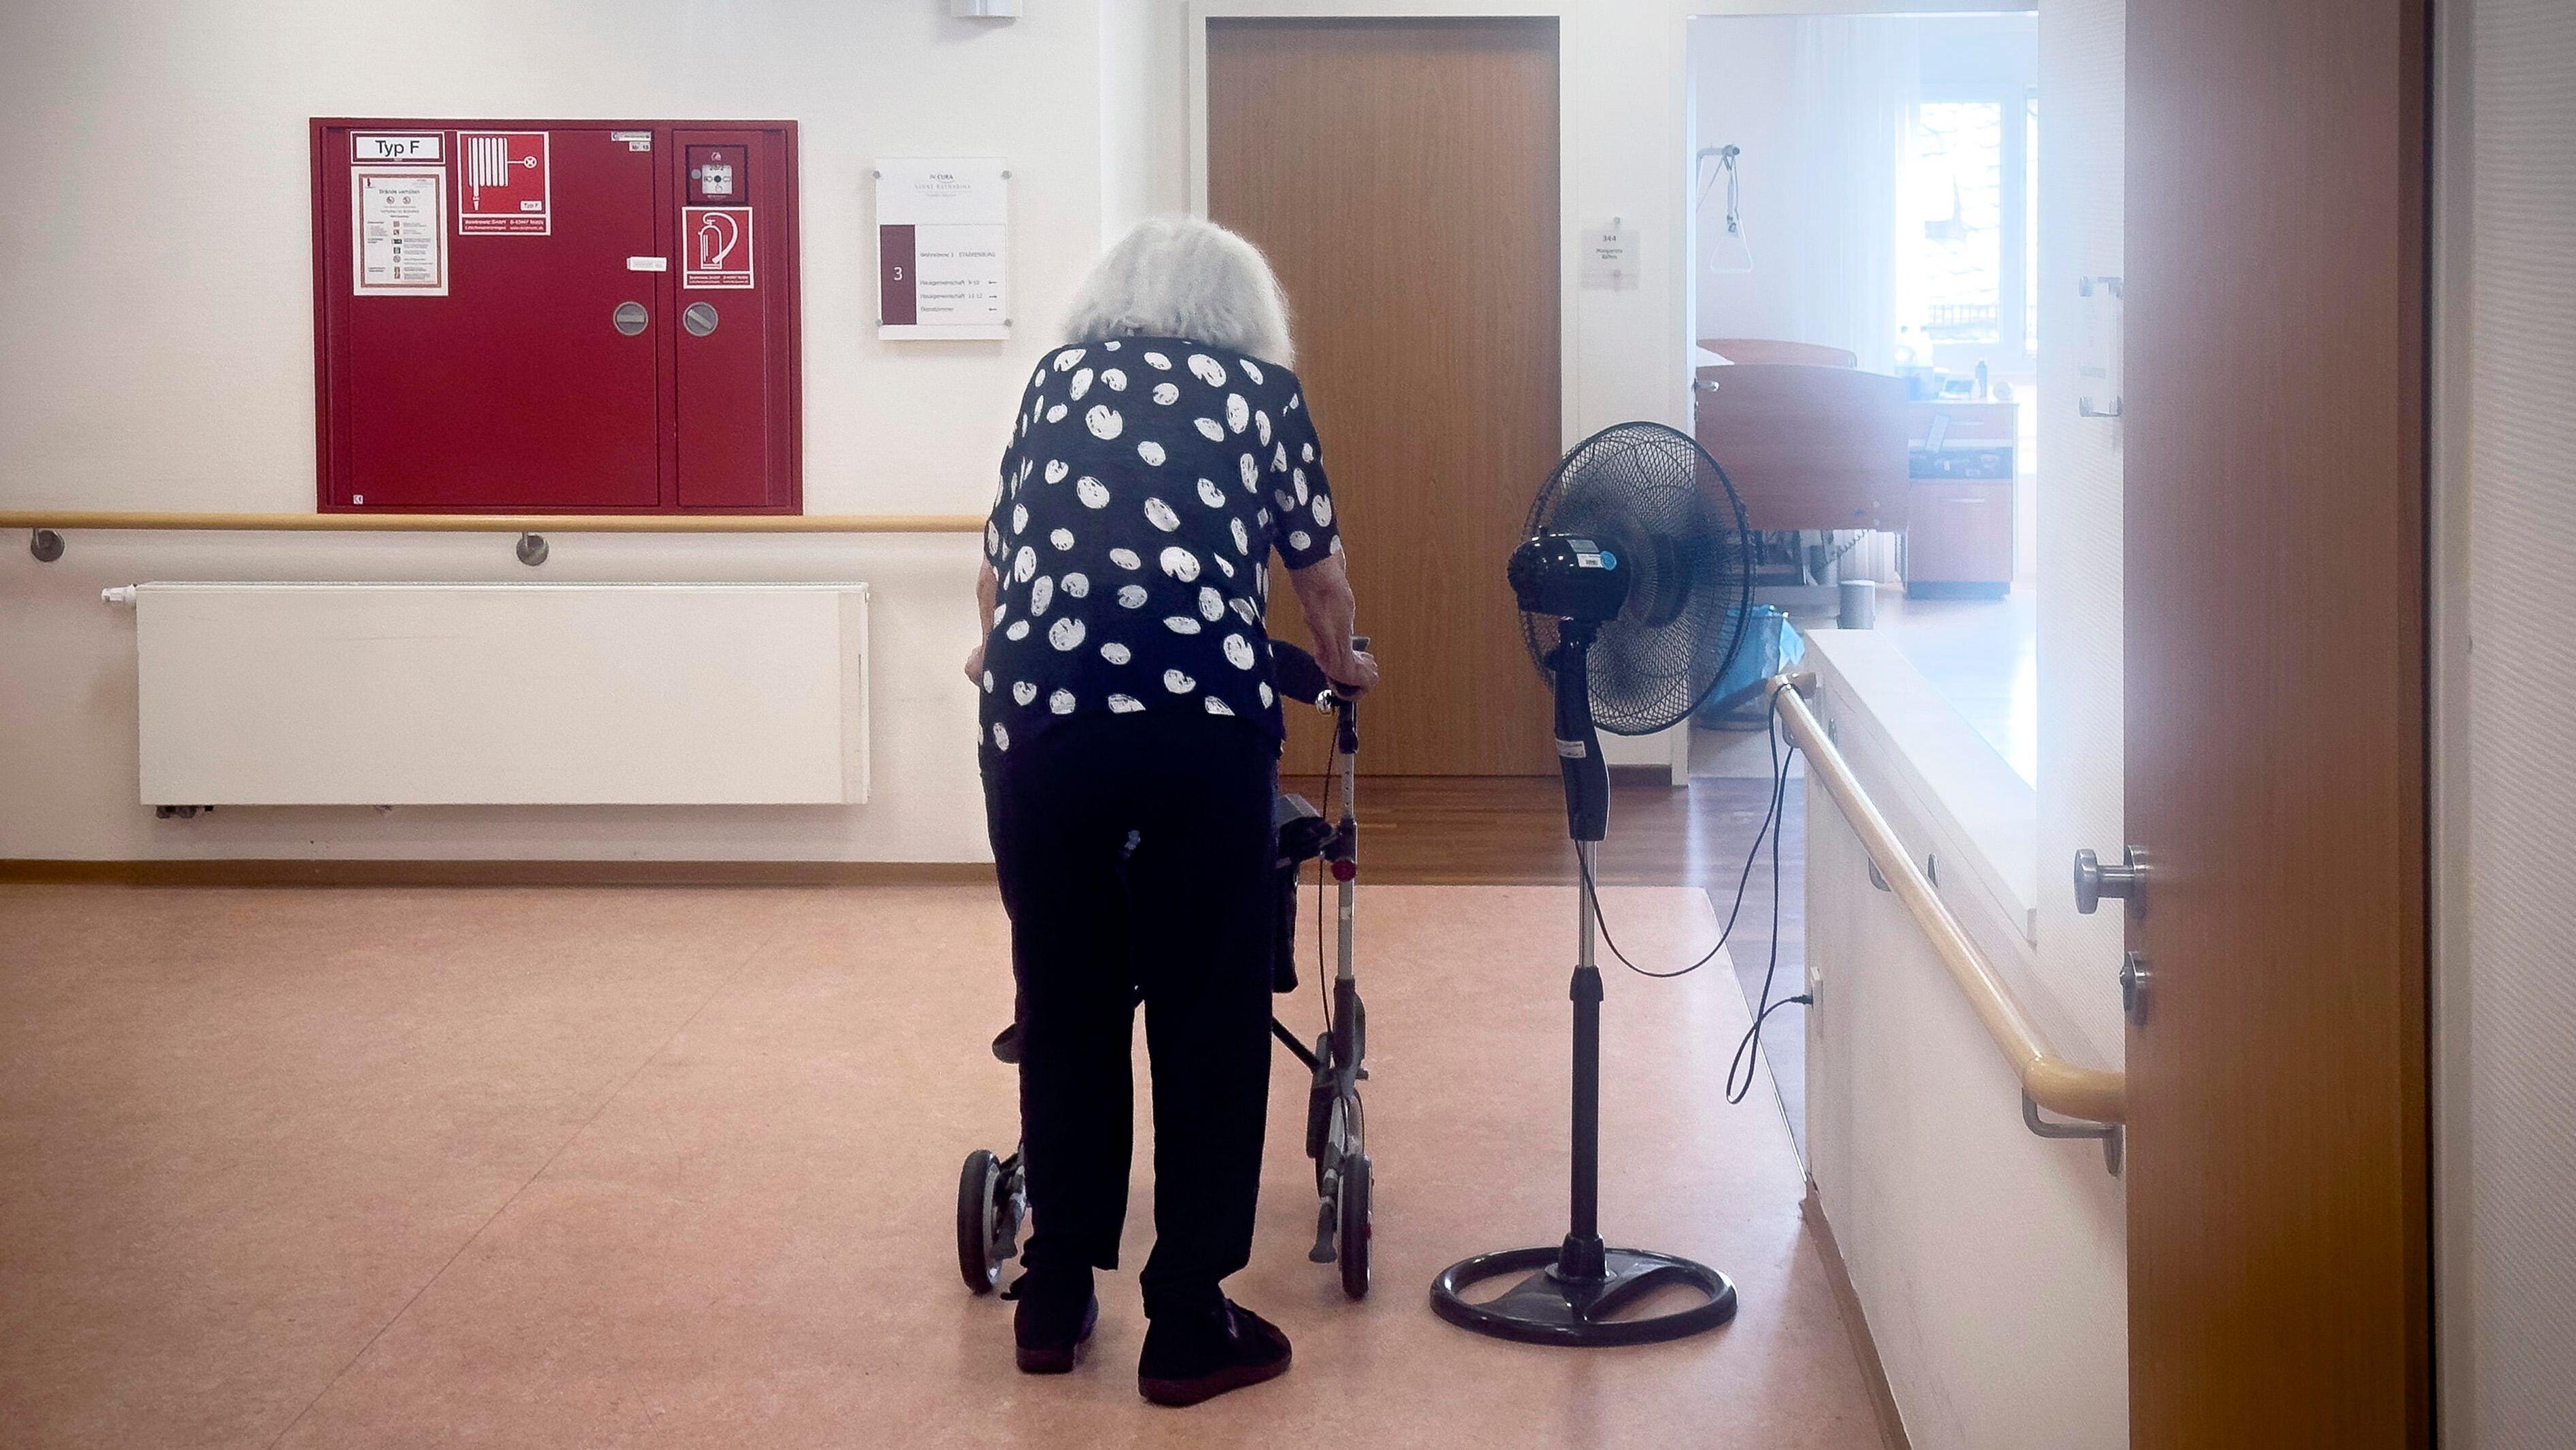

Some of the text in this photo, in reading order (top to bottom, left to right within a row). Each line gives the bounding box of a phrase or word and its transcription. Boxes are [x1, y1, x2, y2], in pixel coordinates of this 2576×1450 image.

[375, 140, 420, 157] Typ F
[894, 266, 903, 281] 3
